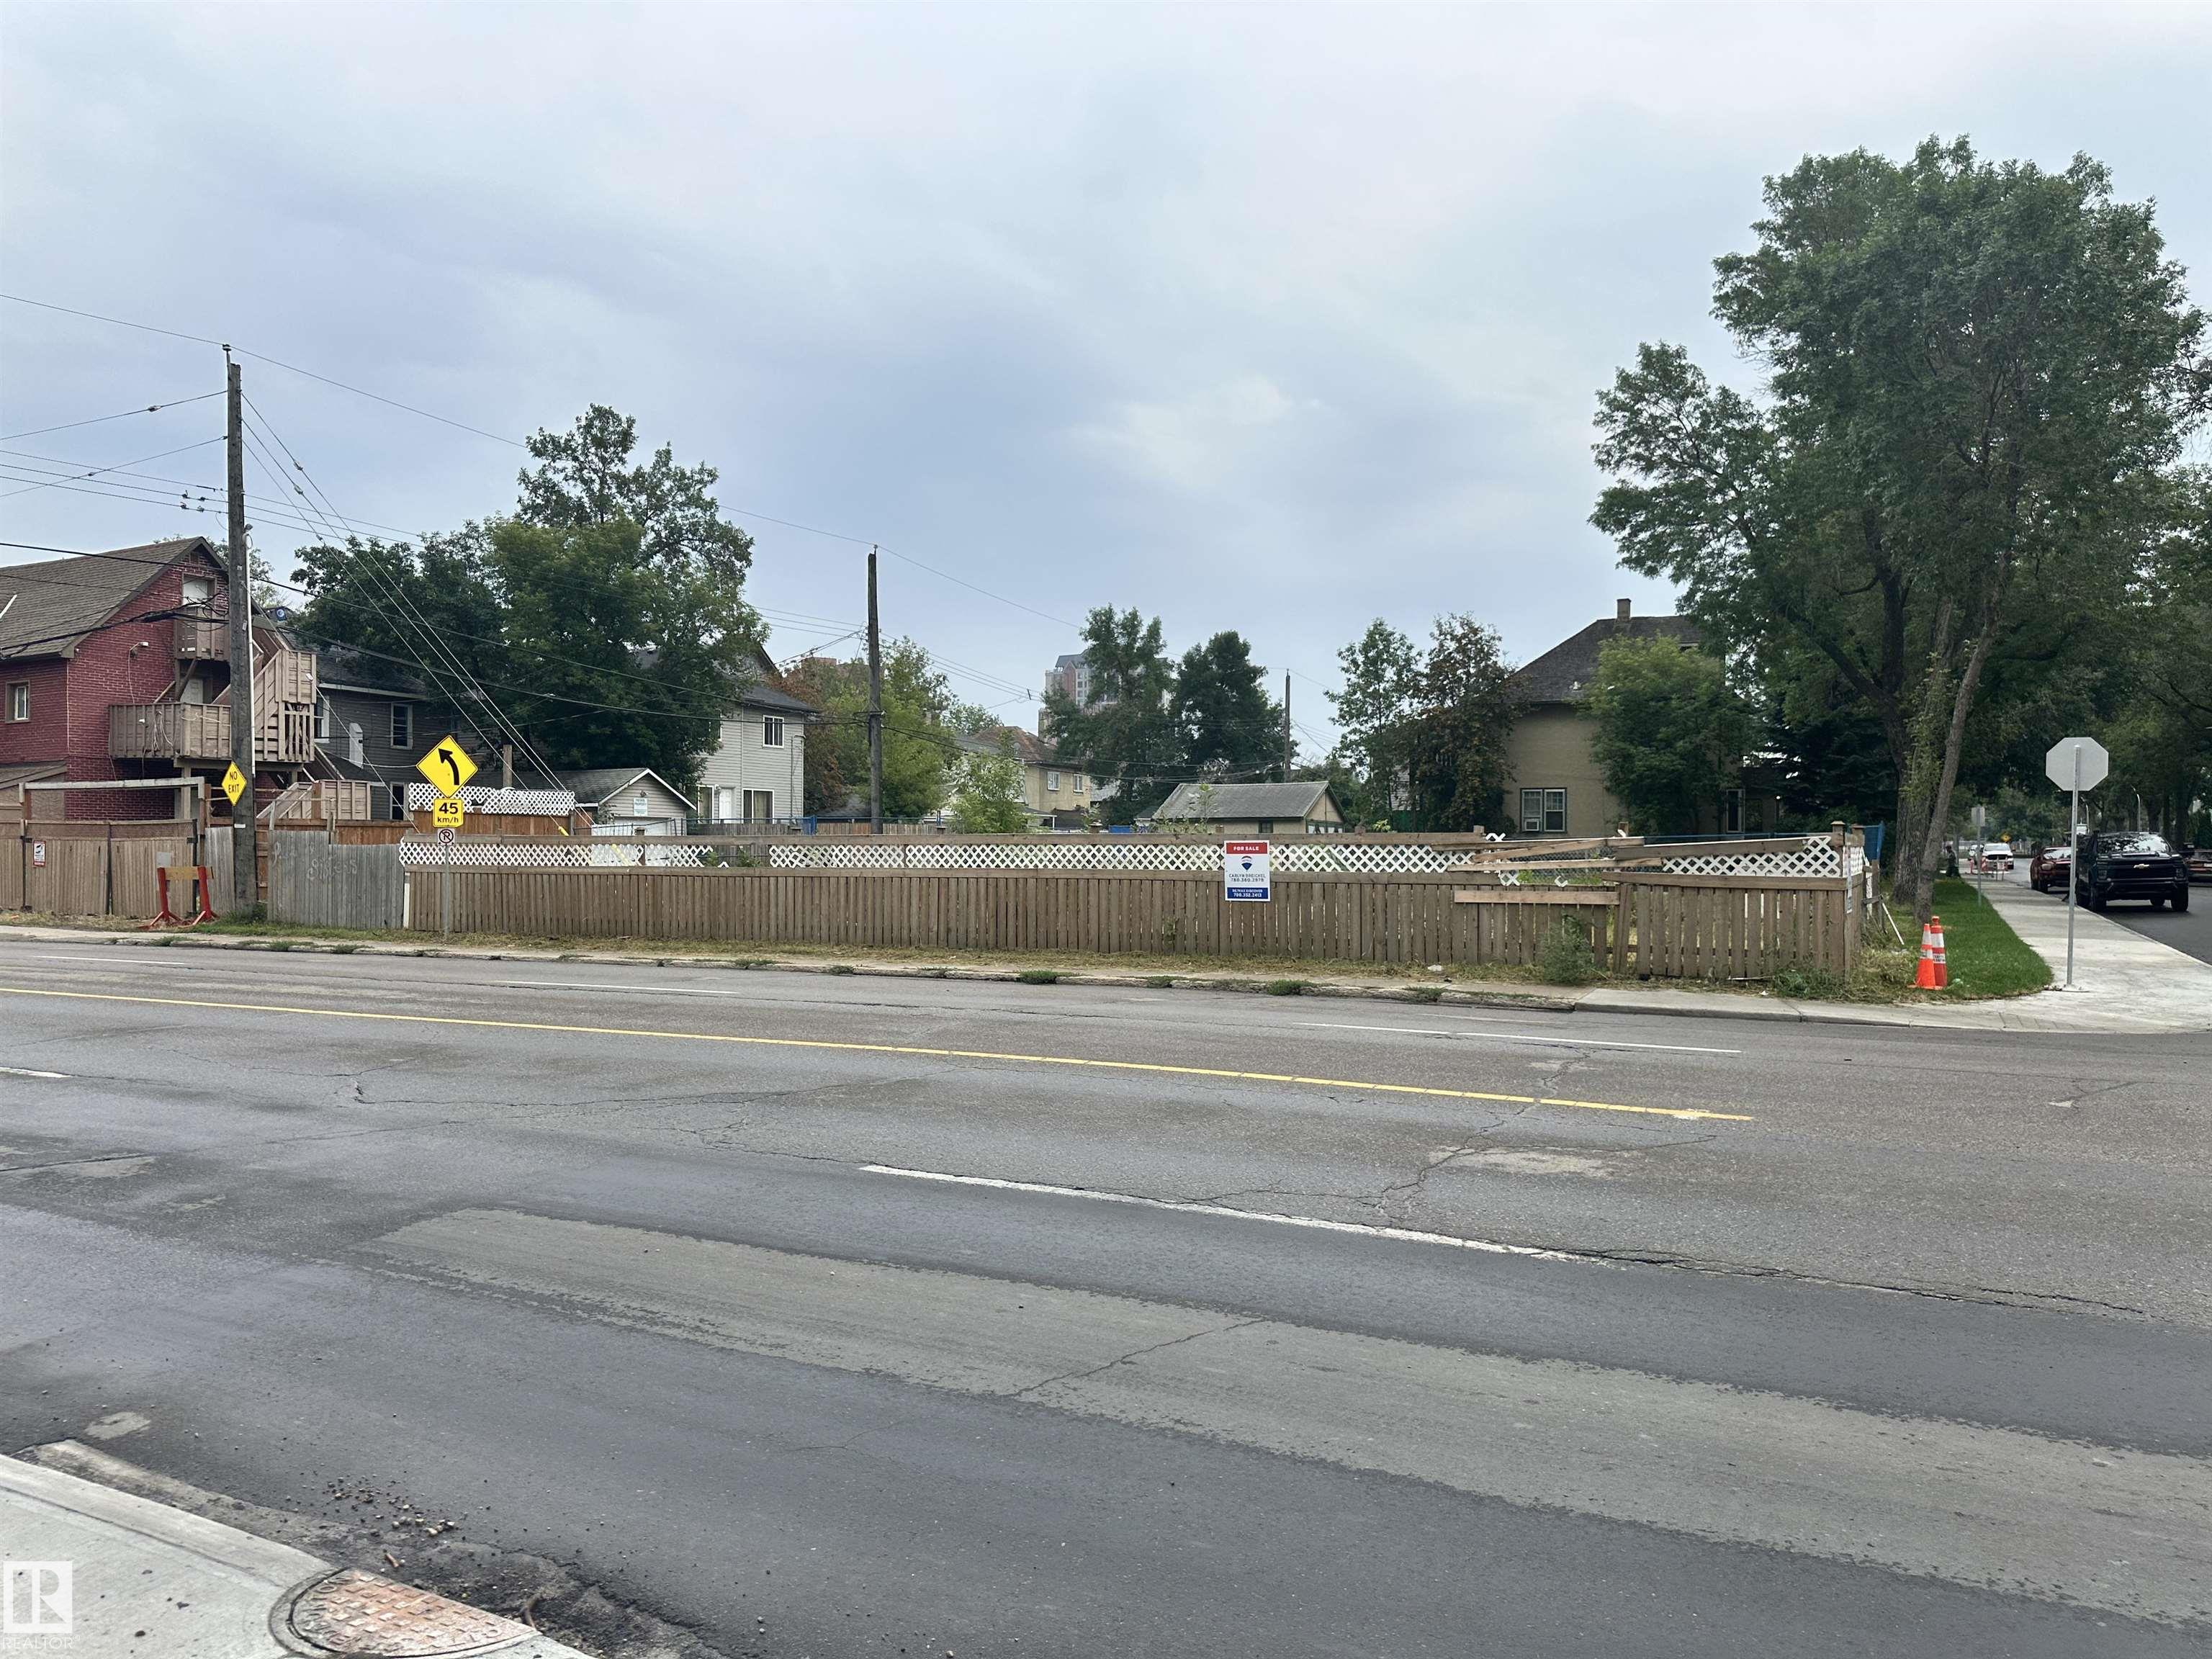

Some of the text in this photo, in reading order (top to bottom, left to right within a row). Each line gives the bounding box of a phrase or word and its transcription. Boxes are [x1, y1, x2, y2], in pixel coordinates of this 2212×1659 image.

[229, 771, 238, 781] NO
[228, 783, 239, 793] EXIT
[439, 802, 459, 814] 45
